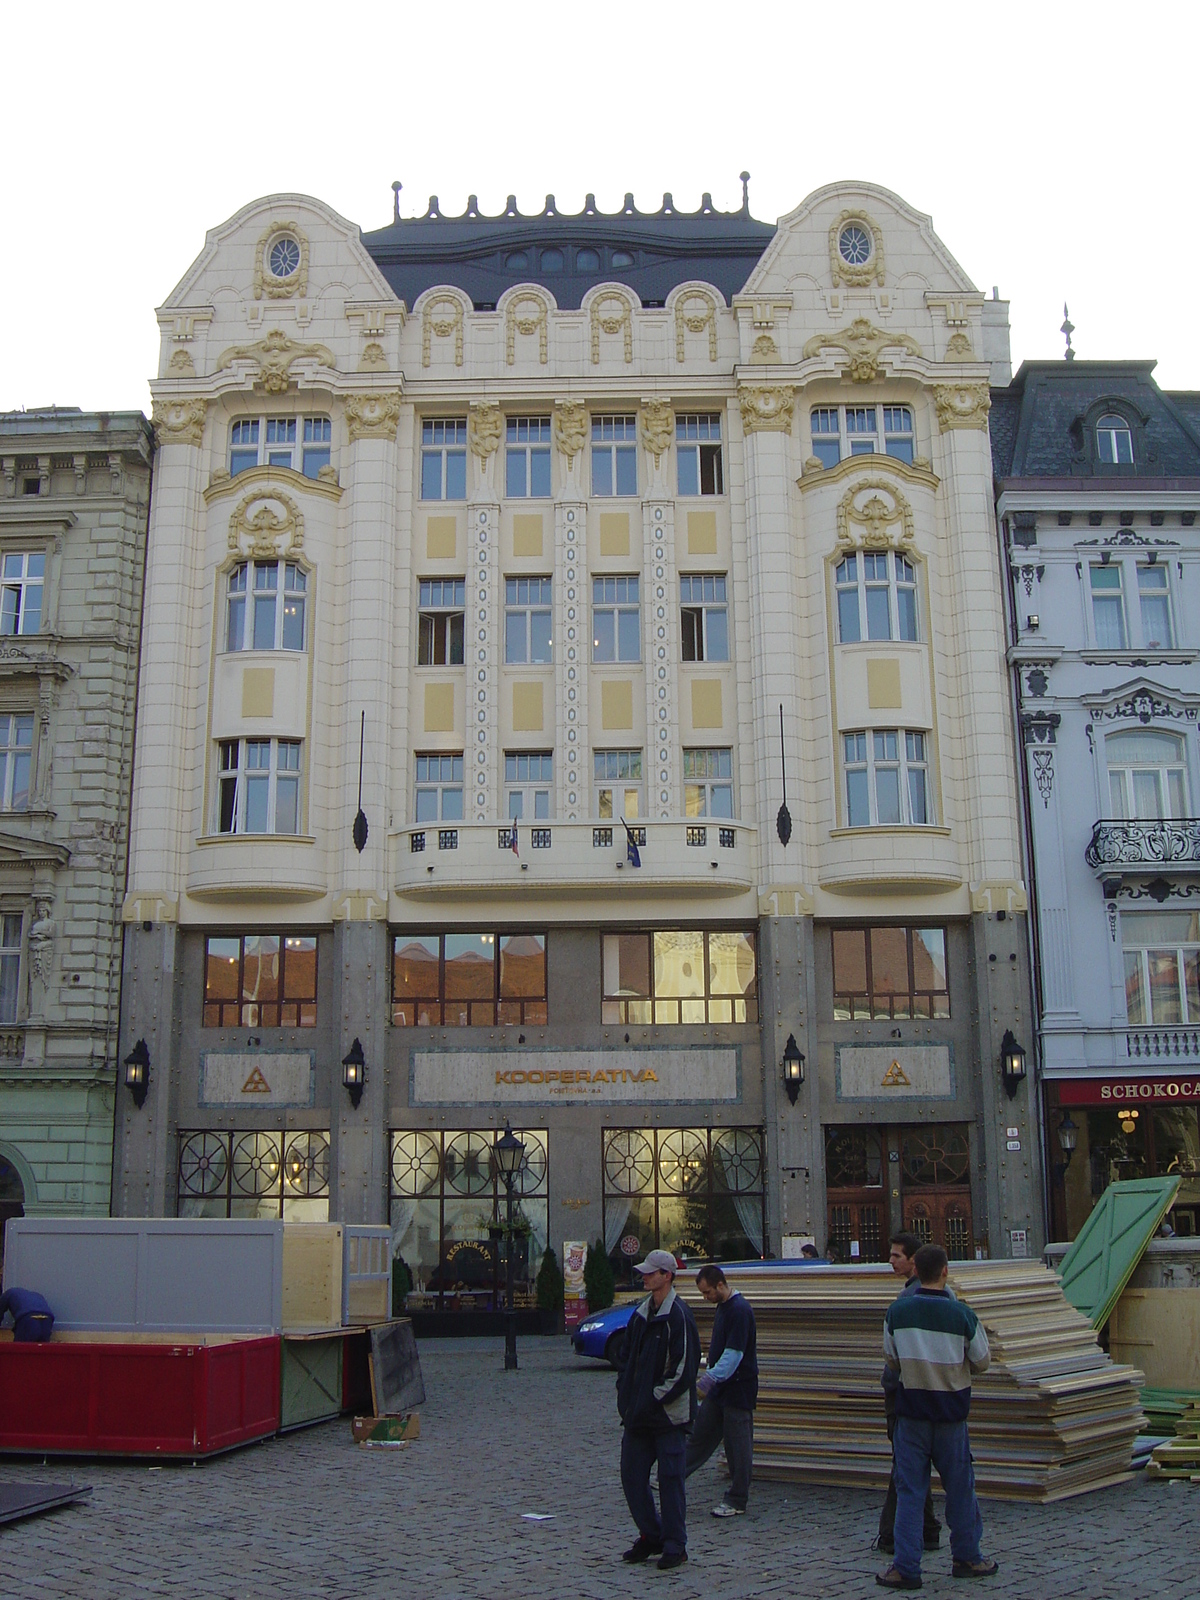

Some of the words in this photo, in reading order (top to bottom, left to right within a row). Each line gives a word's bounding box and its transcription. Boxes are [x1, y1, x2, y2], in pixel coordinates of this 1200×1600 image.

[495, 1069, 659, 1084] KOOPERATIVA
[1101, 1082, 1200, 1099] SCHOKOCA
[892, 1188, 899, 1197] 5
[446, 1241, 491, 1261] RESTAURANT
[664, 1239, 709, 1259] STAURANT
